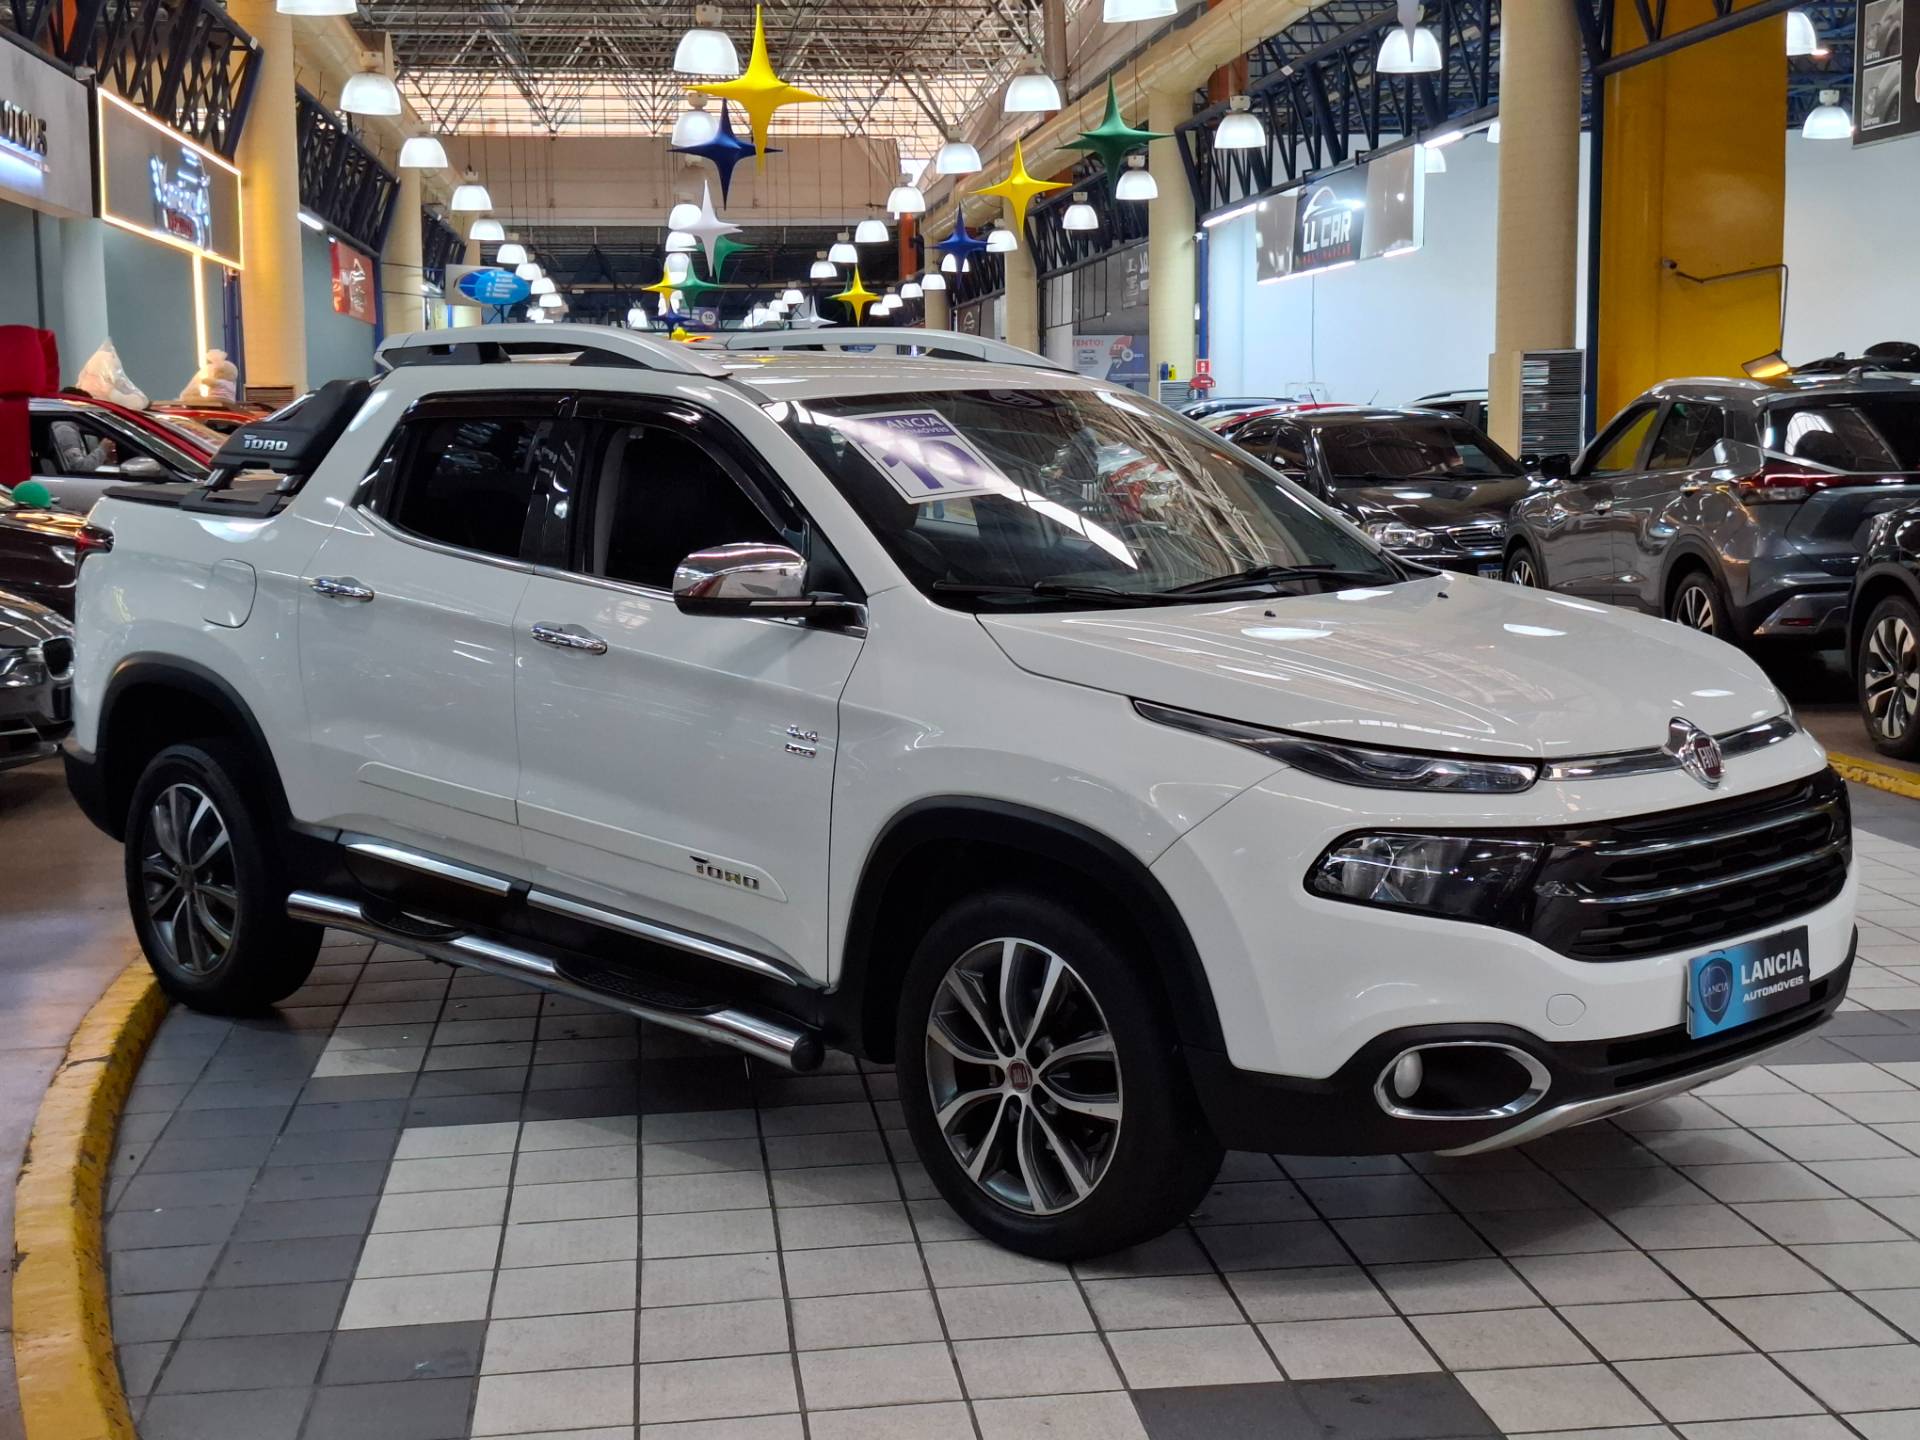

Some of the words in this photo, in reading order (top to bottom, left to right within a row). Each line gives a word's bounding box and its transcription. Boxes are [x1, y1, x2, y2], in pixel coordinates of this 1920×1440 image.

[1303, 221, 1317, 252] LL
[1321, 210, 1353, 248] CAR
[243, 434, 288, 451] TORO
[689, 855, 760, 890] TORO
[1740, 948, 1803, 985] LANCIA
